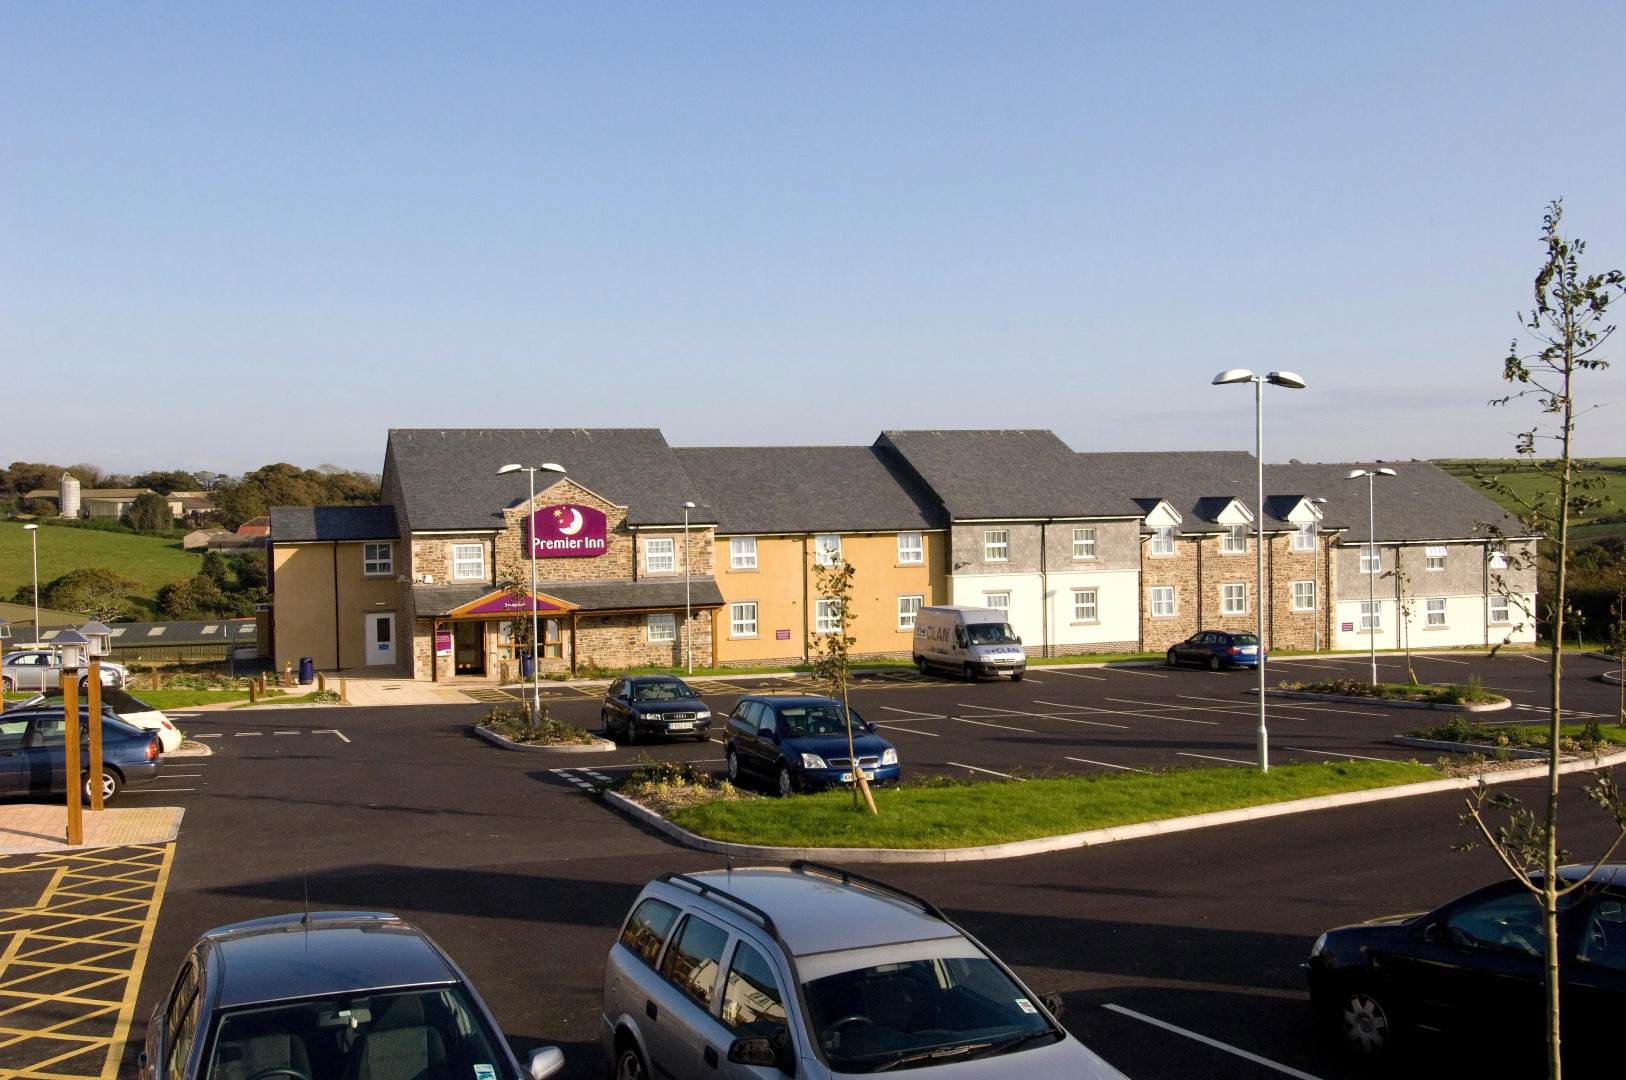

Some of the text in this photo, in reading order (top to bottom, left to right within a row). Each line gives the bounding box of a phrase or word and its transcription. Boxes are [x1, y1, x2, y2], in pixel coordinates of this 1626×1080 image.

[533, 536, 605, 550] Premier Inn
[927, 625, 950, 643] CLAN
